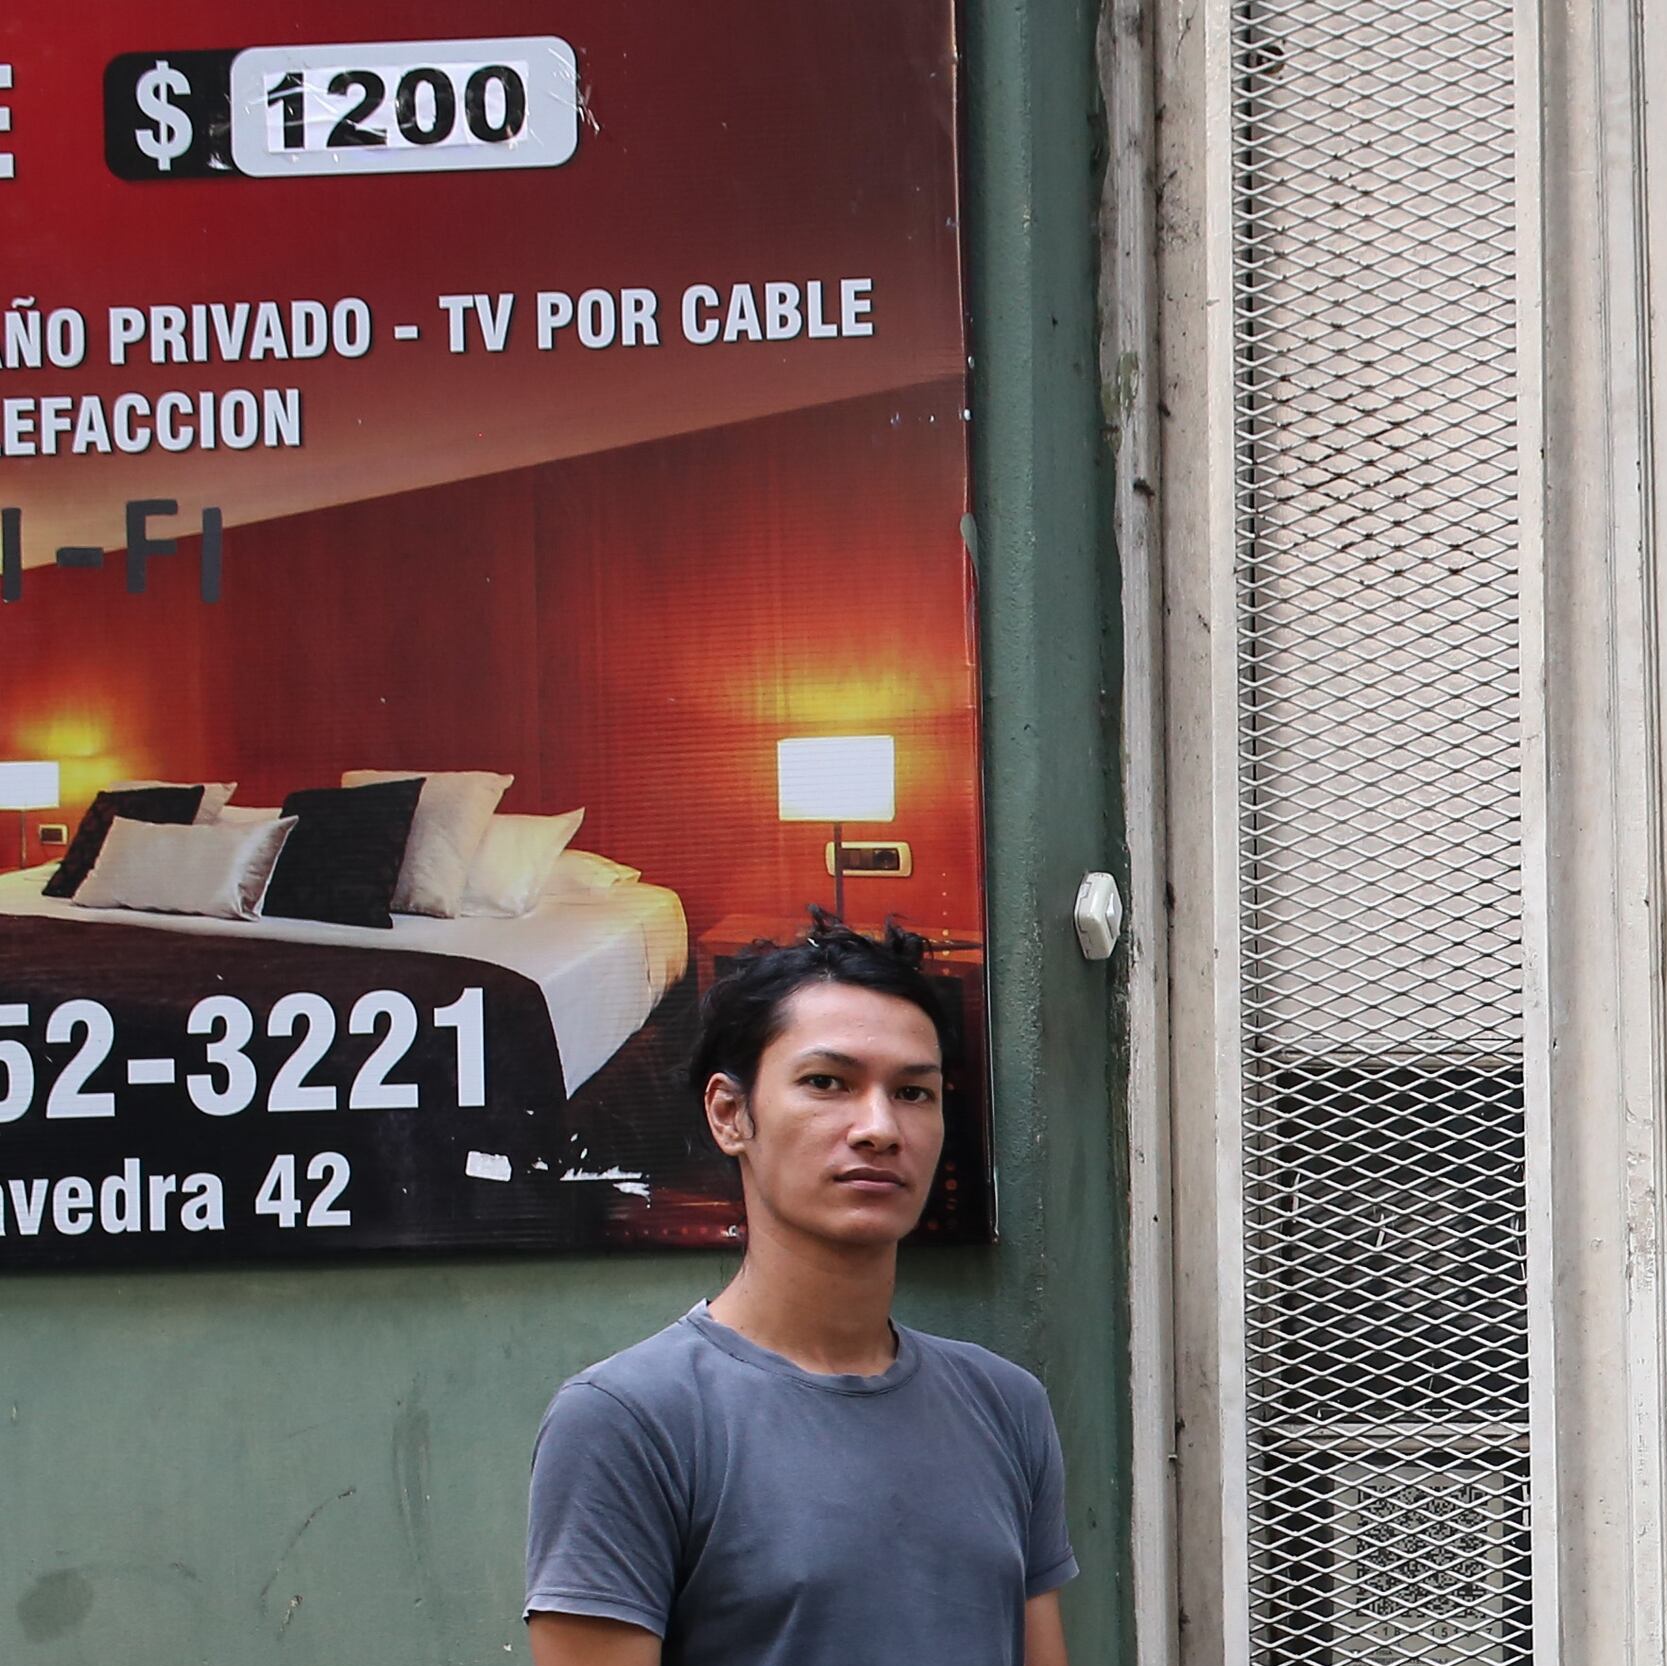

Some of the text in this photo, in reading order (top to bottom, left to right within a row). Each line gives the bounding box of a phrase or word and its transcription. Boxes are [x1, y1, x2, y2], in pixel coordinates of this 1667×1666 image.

[134, 60, 526, 171] $ 1200
[0, 278, 874, 369] ÑO PRIVADO - TV POR CABLE
[0, 388, 301, 457] EFACCION
[0, 1151, 351, 1236] vedra 42
